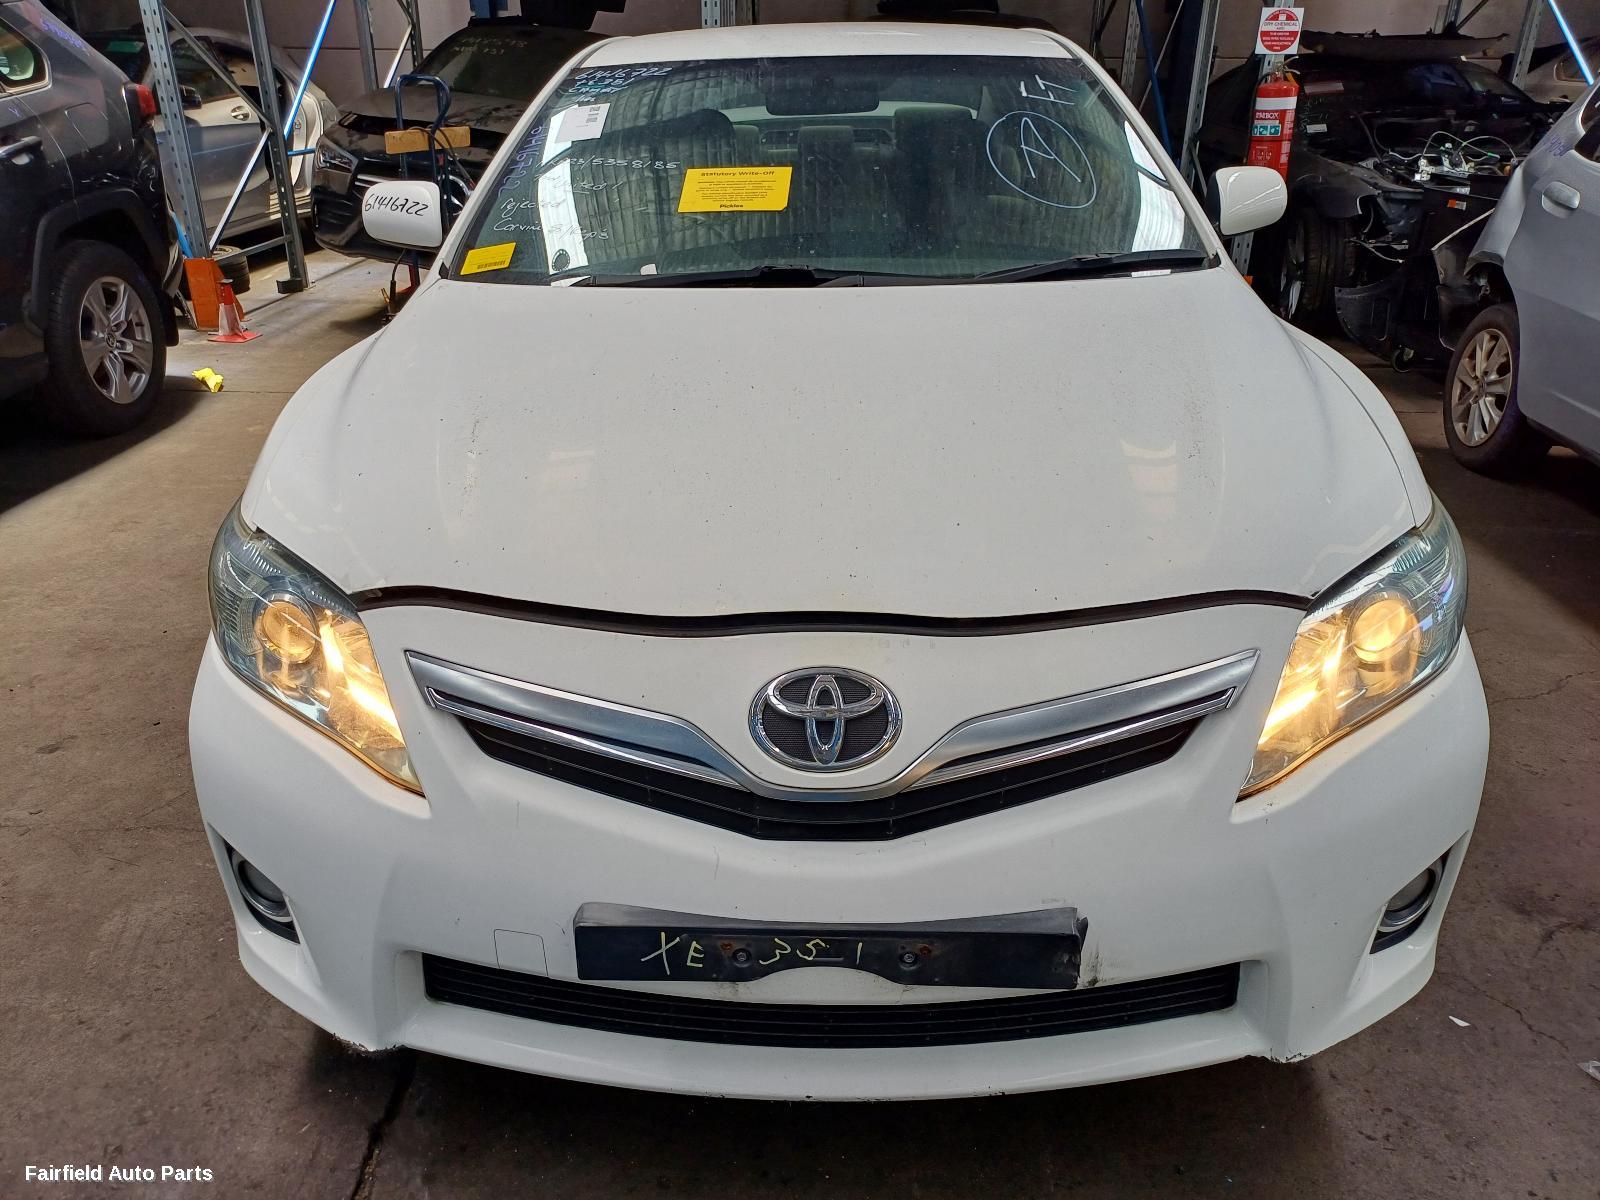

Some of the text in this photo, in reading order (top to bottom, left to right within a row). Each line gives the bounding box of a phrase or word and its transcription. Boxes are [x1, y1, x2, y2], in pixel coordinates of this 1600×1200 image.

[701, 169, 775, 178] Statutory Write-Off
[364, 193, 429, 216] 61416722
